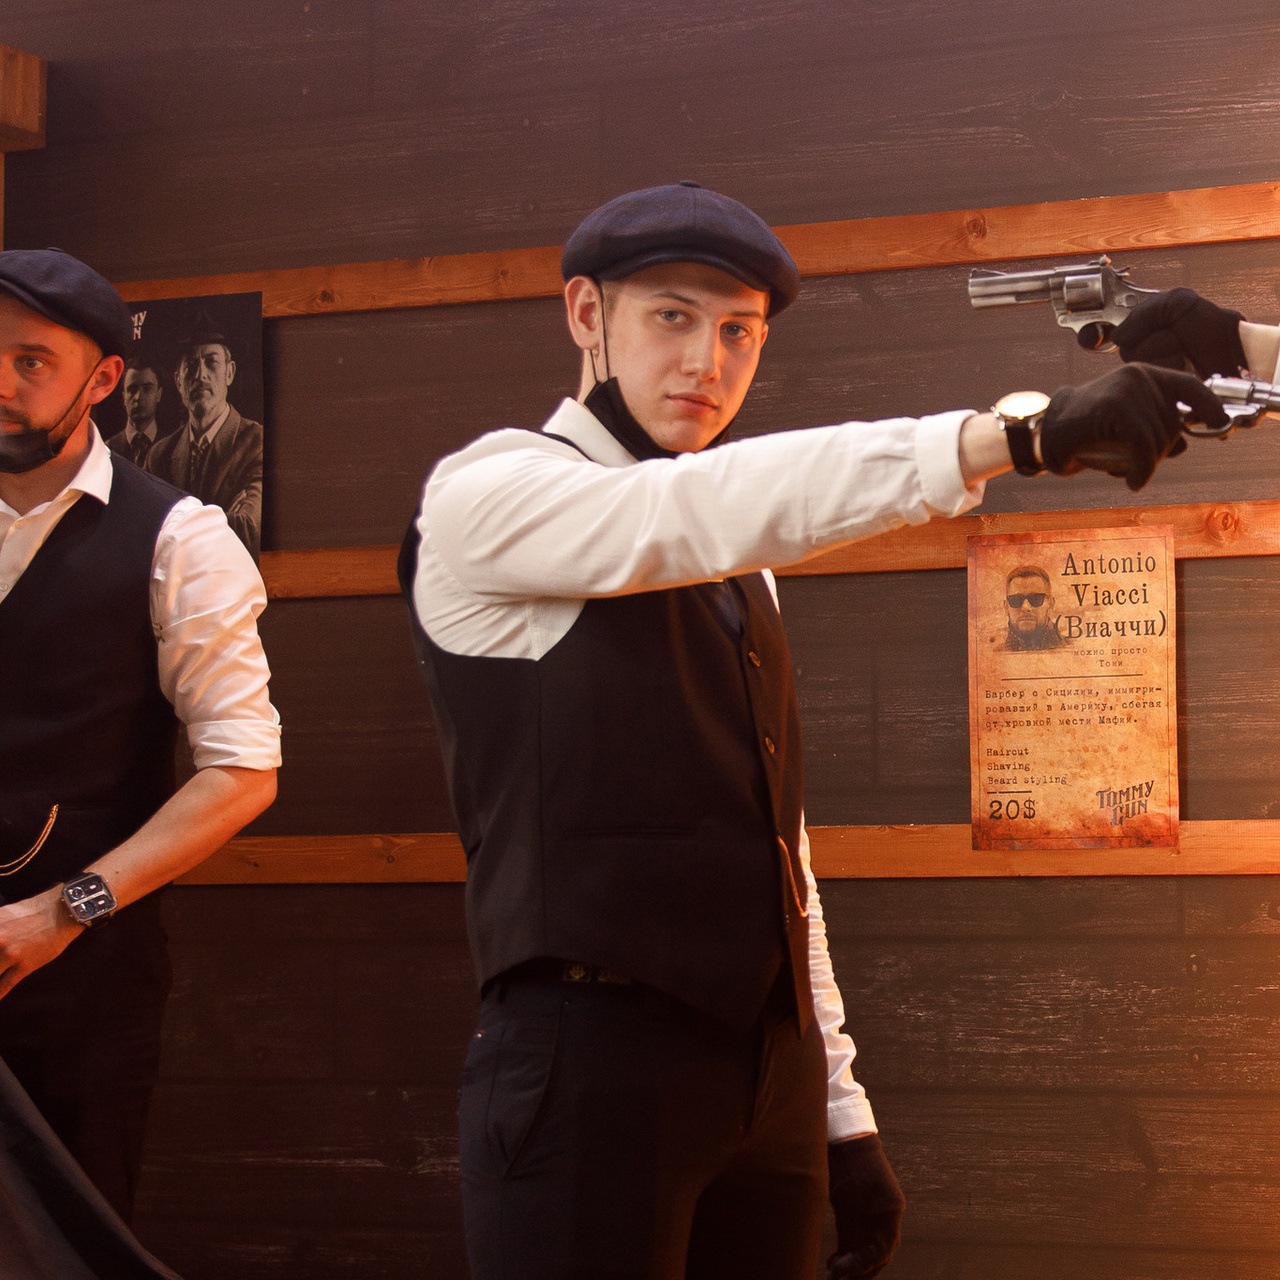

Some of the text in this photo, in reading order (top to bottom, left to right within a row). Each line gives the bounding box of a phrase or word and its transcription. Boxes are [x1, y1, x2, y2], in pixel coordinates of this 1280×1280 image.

[1061, 551, 1156, 576] Antonio
[1070, 583, 1149, 607] Viacci
[1055, 609, 1166, 640] (Виаччи)
[1074, 647, 1148, 657] можно просто
[1099, 659, 1123, 668] Тони
[985, 689, 1025, 699] Барбер
[1046, 688, 1099, 697] Сицилии,
[1121, 700, 1162, 709] сбегая
[1098, 715, 1138, 725] Мафии.
[986, 747, 1029, 756] Haircut
[987, 762, 1030, 771] Shaving
[987, 775, 1067, 785] Beard styling
[1095, 780, 1154, 809] TOMMY
[989, 797, 1036, 820] 20$
[1110, 799, 1148, 826] GUN
